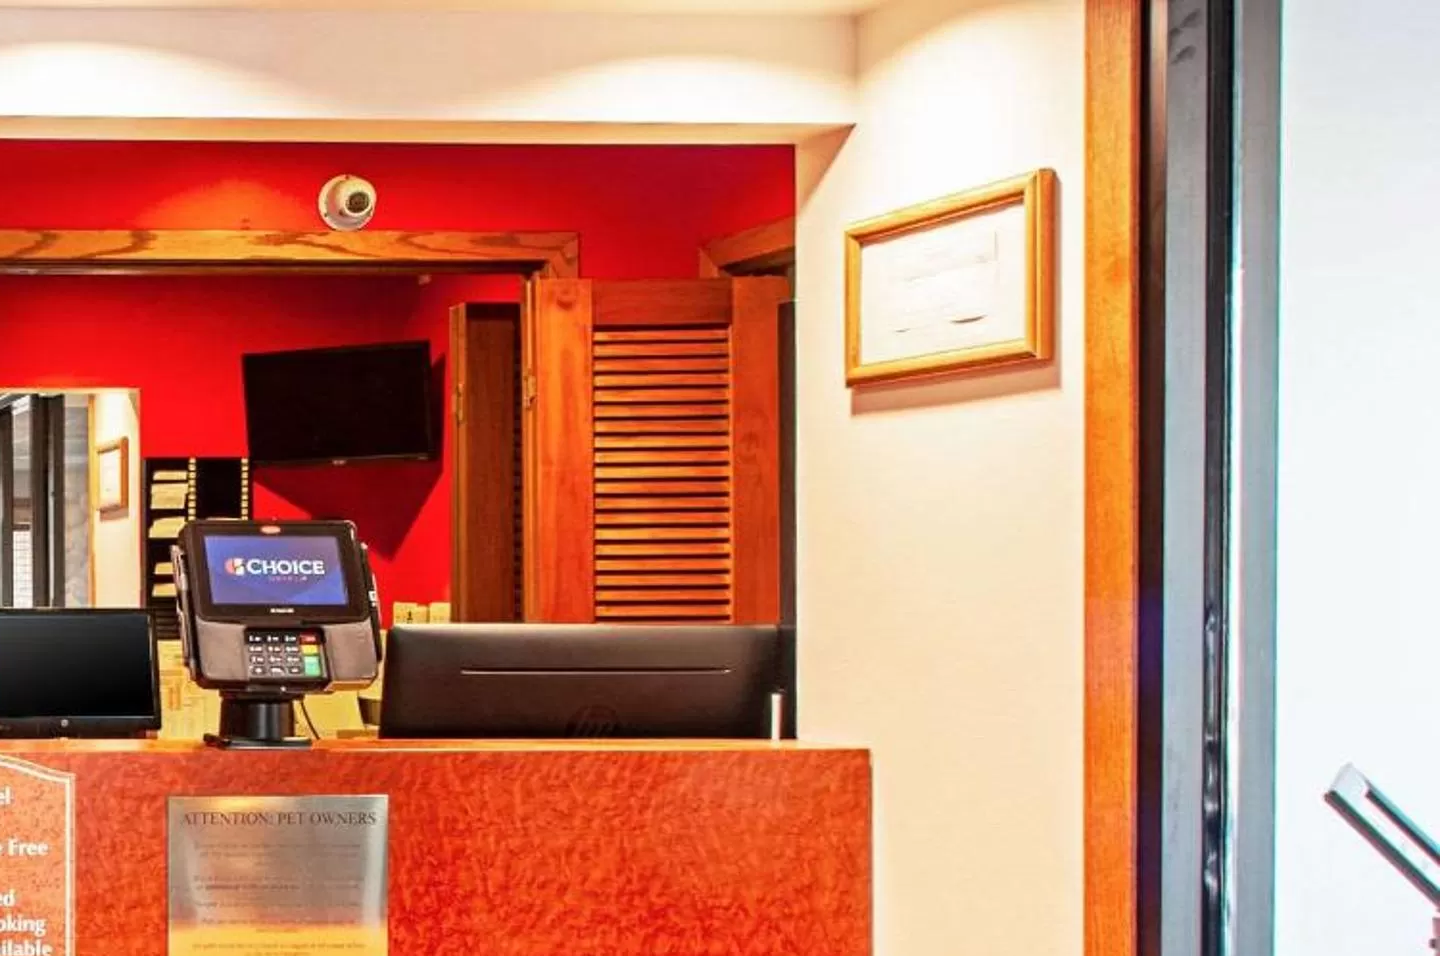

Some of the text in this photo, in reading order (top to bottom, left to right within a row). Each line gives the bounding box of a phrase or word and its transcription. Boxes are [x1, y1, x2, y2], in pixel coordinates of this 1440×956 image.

[246, 558, 326, 576] CHOICE
[181, 811, 377, 826] ATTENTION: PET OWNERS
[8, 838, 49, 857] Free
